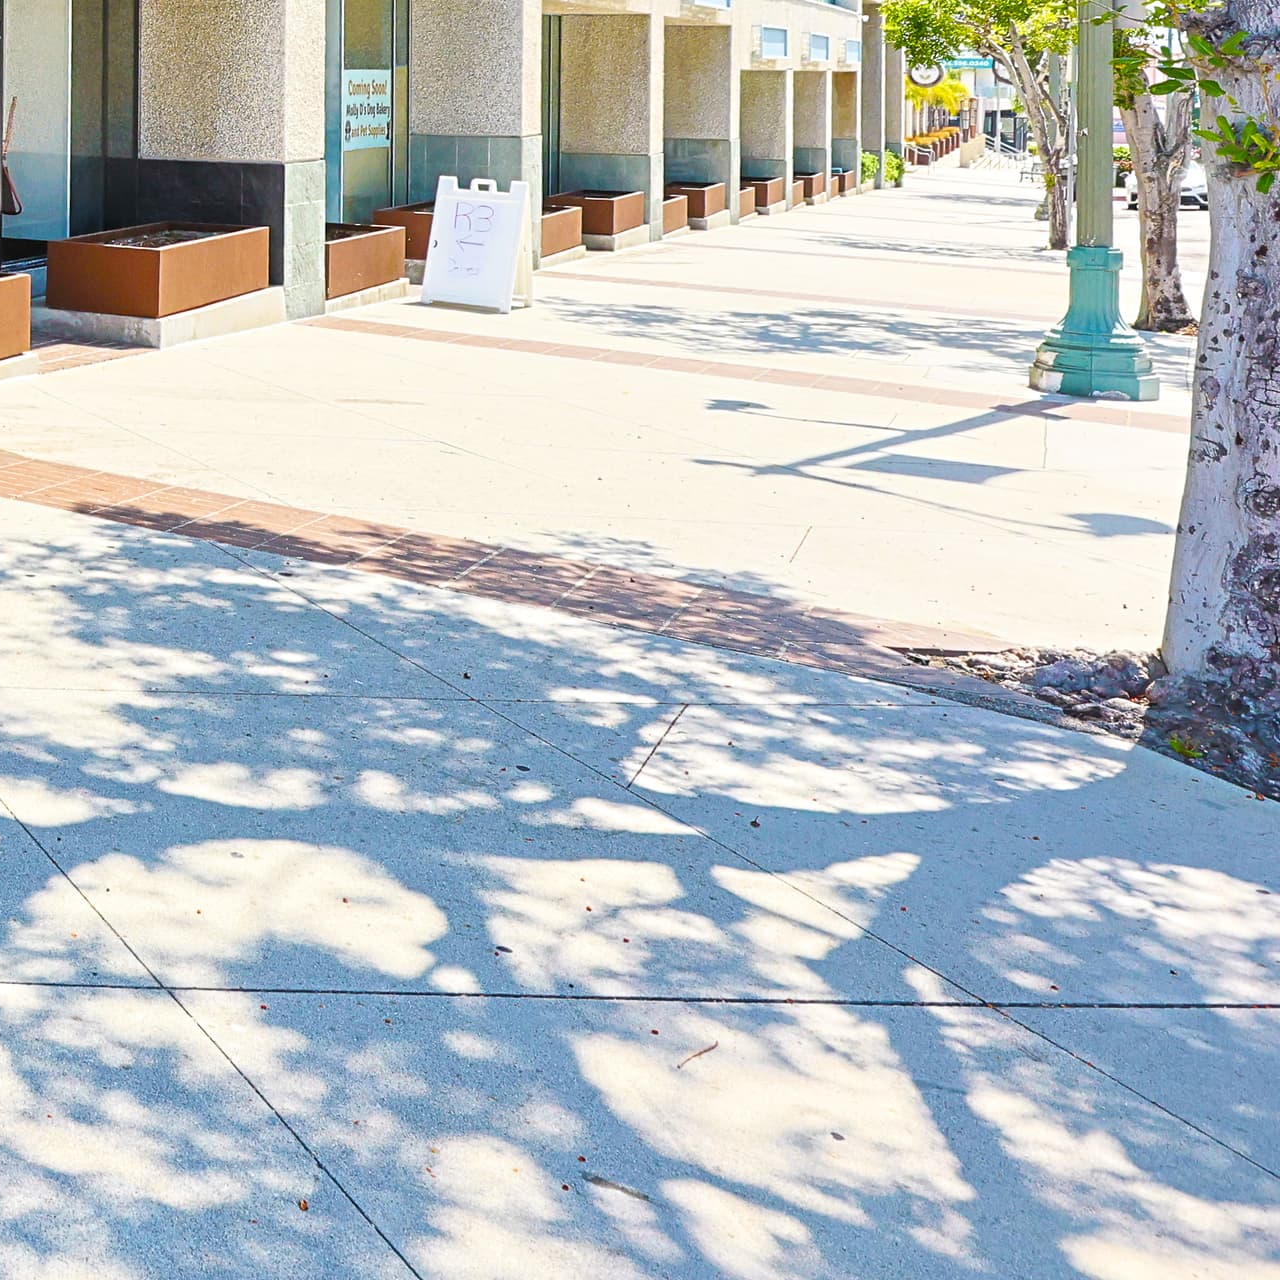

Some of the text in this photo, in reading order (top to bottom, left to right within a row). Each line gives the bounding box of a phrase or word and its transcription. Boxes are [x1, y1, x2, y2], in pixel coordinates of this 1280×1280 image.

[349, 79, 371, 99] Coming
[346, 104, 359, 119] Molly
[367, 103, 376, 118] Dog
[376, 102, 391, 118] Bakery
[351, 124, 359, 138] and
[368, 124, 386, 139] Supplies
